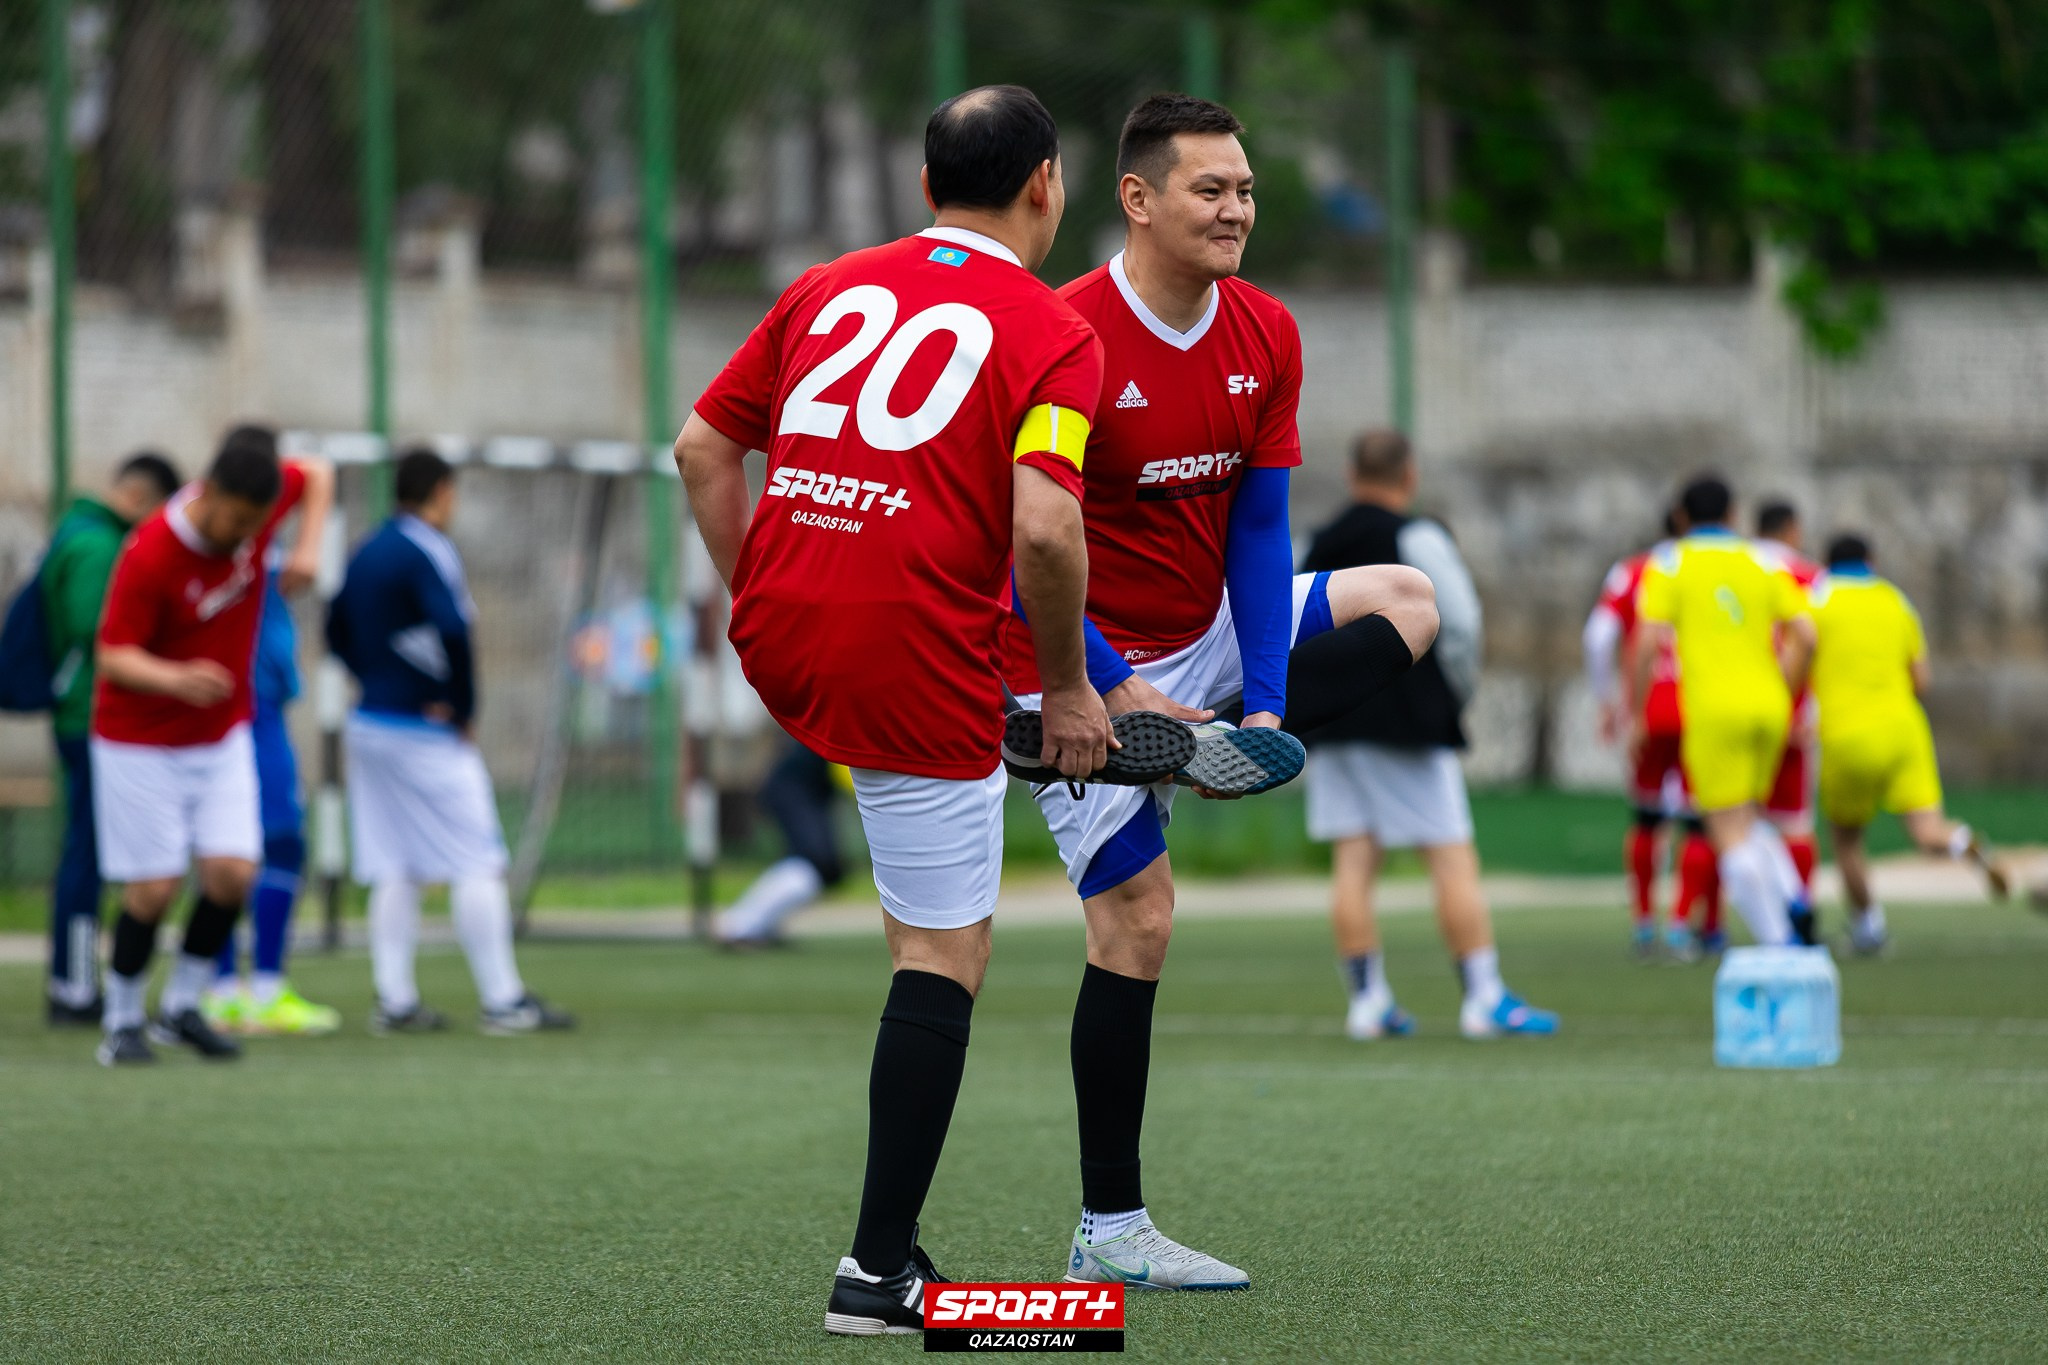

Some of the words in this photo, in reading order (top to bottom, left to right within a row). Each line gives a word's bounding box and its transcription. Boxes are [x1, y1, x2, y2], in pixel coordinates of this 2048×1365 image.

[778, 284, 993, 451] 20
[1228, 375, 1259, 394] S+
[1115, 398, 1149, 409] adidas
[1137, 452, 1242, 484] SPORT+
[767, 466, 912, 518] SPORT+
[1165, 483, 1220, 498] QAZAQSTAN
[791, 510, 864, 534] QAZAQSTAN
